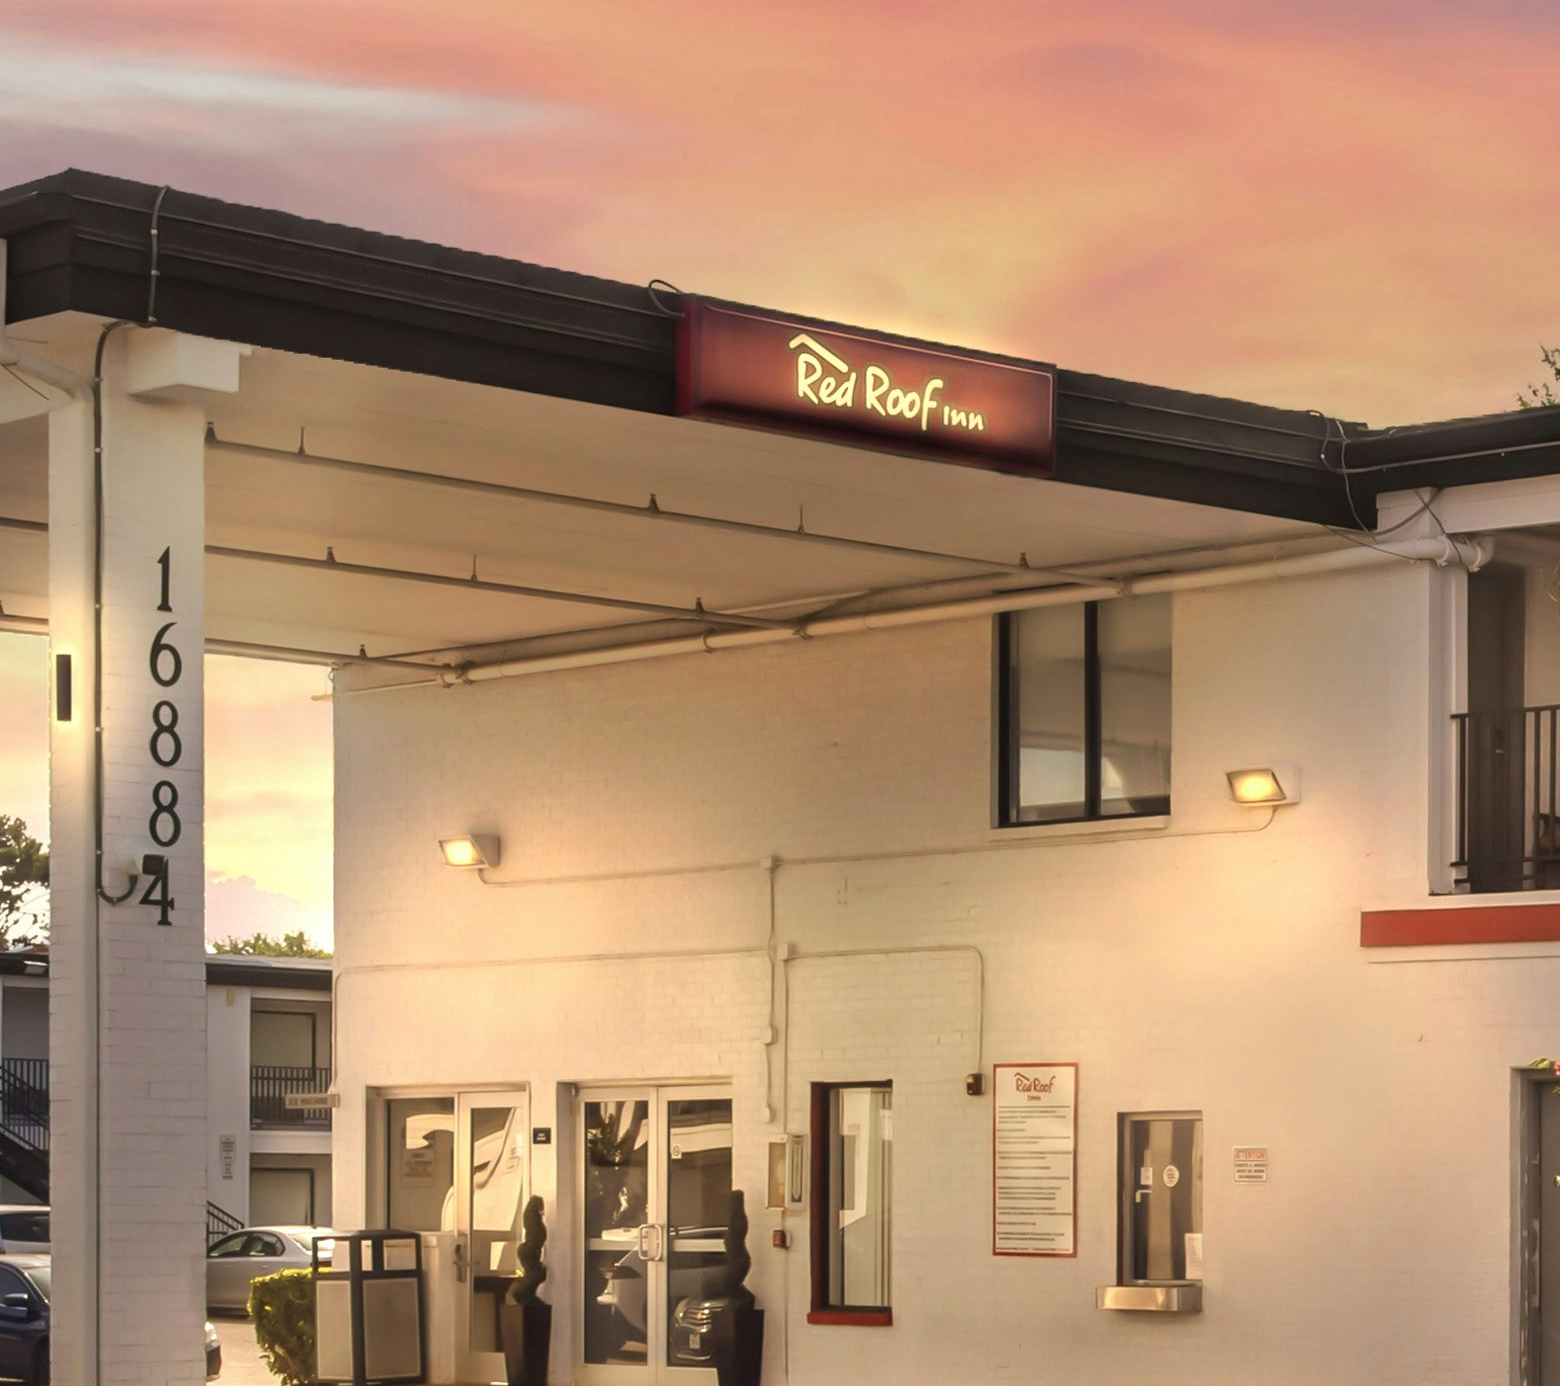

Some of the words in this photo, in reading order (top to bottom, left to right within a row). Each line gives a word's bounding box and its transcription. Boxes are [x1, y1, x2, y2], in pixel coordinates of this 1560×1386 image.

[797, 352, 857, 408] Red
[865, 365, 944, 431] Roof
[138, 545, 183, 926] 16884
[1015, 1077, 1032, 1092] Red
[1033, 1075, 1056, 1093] Roof
